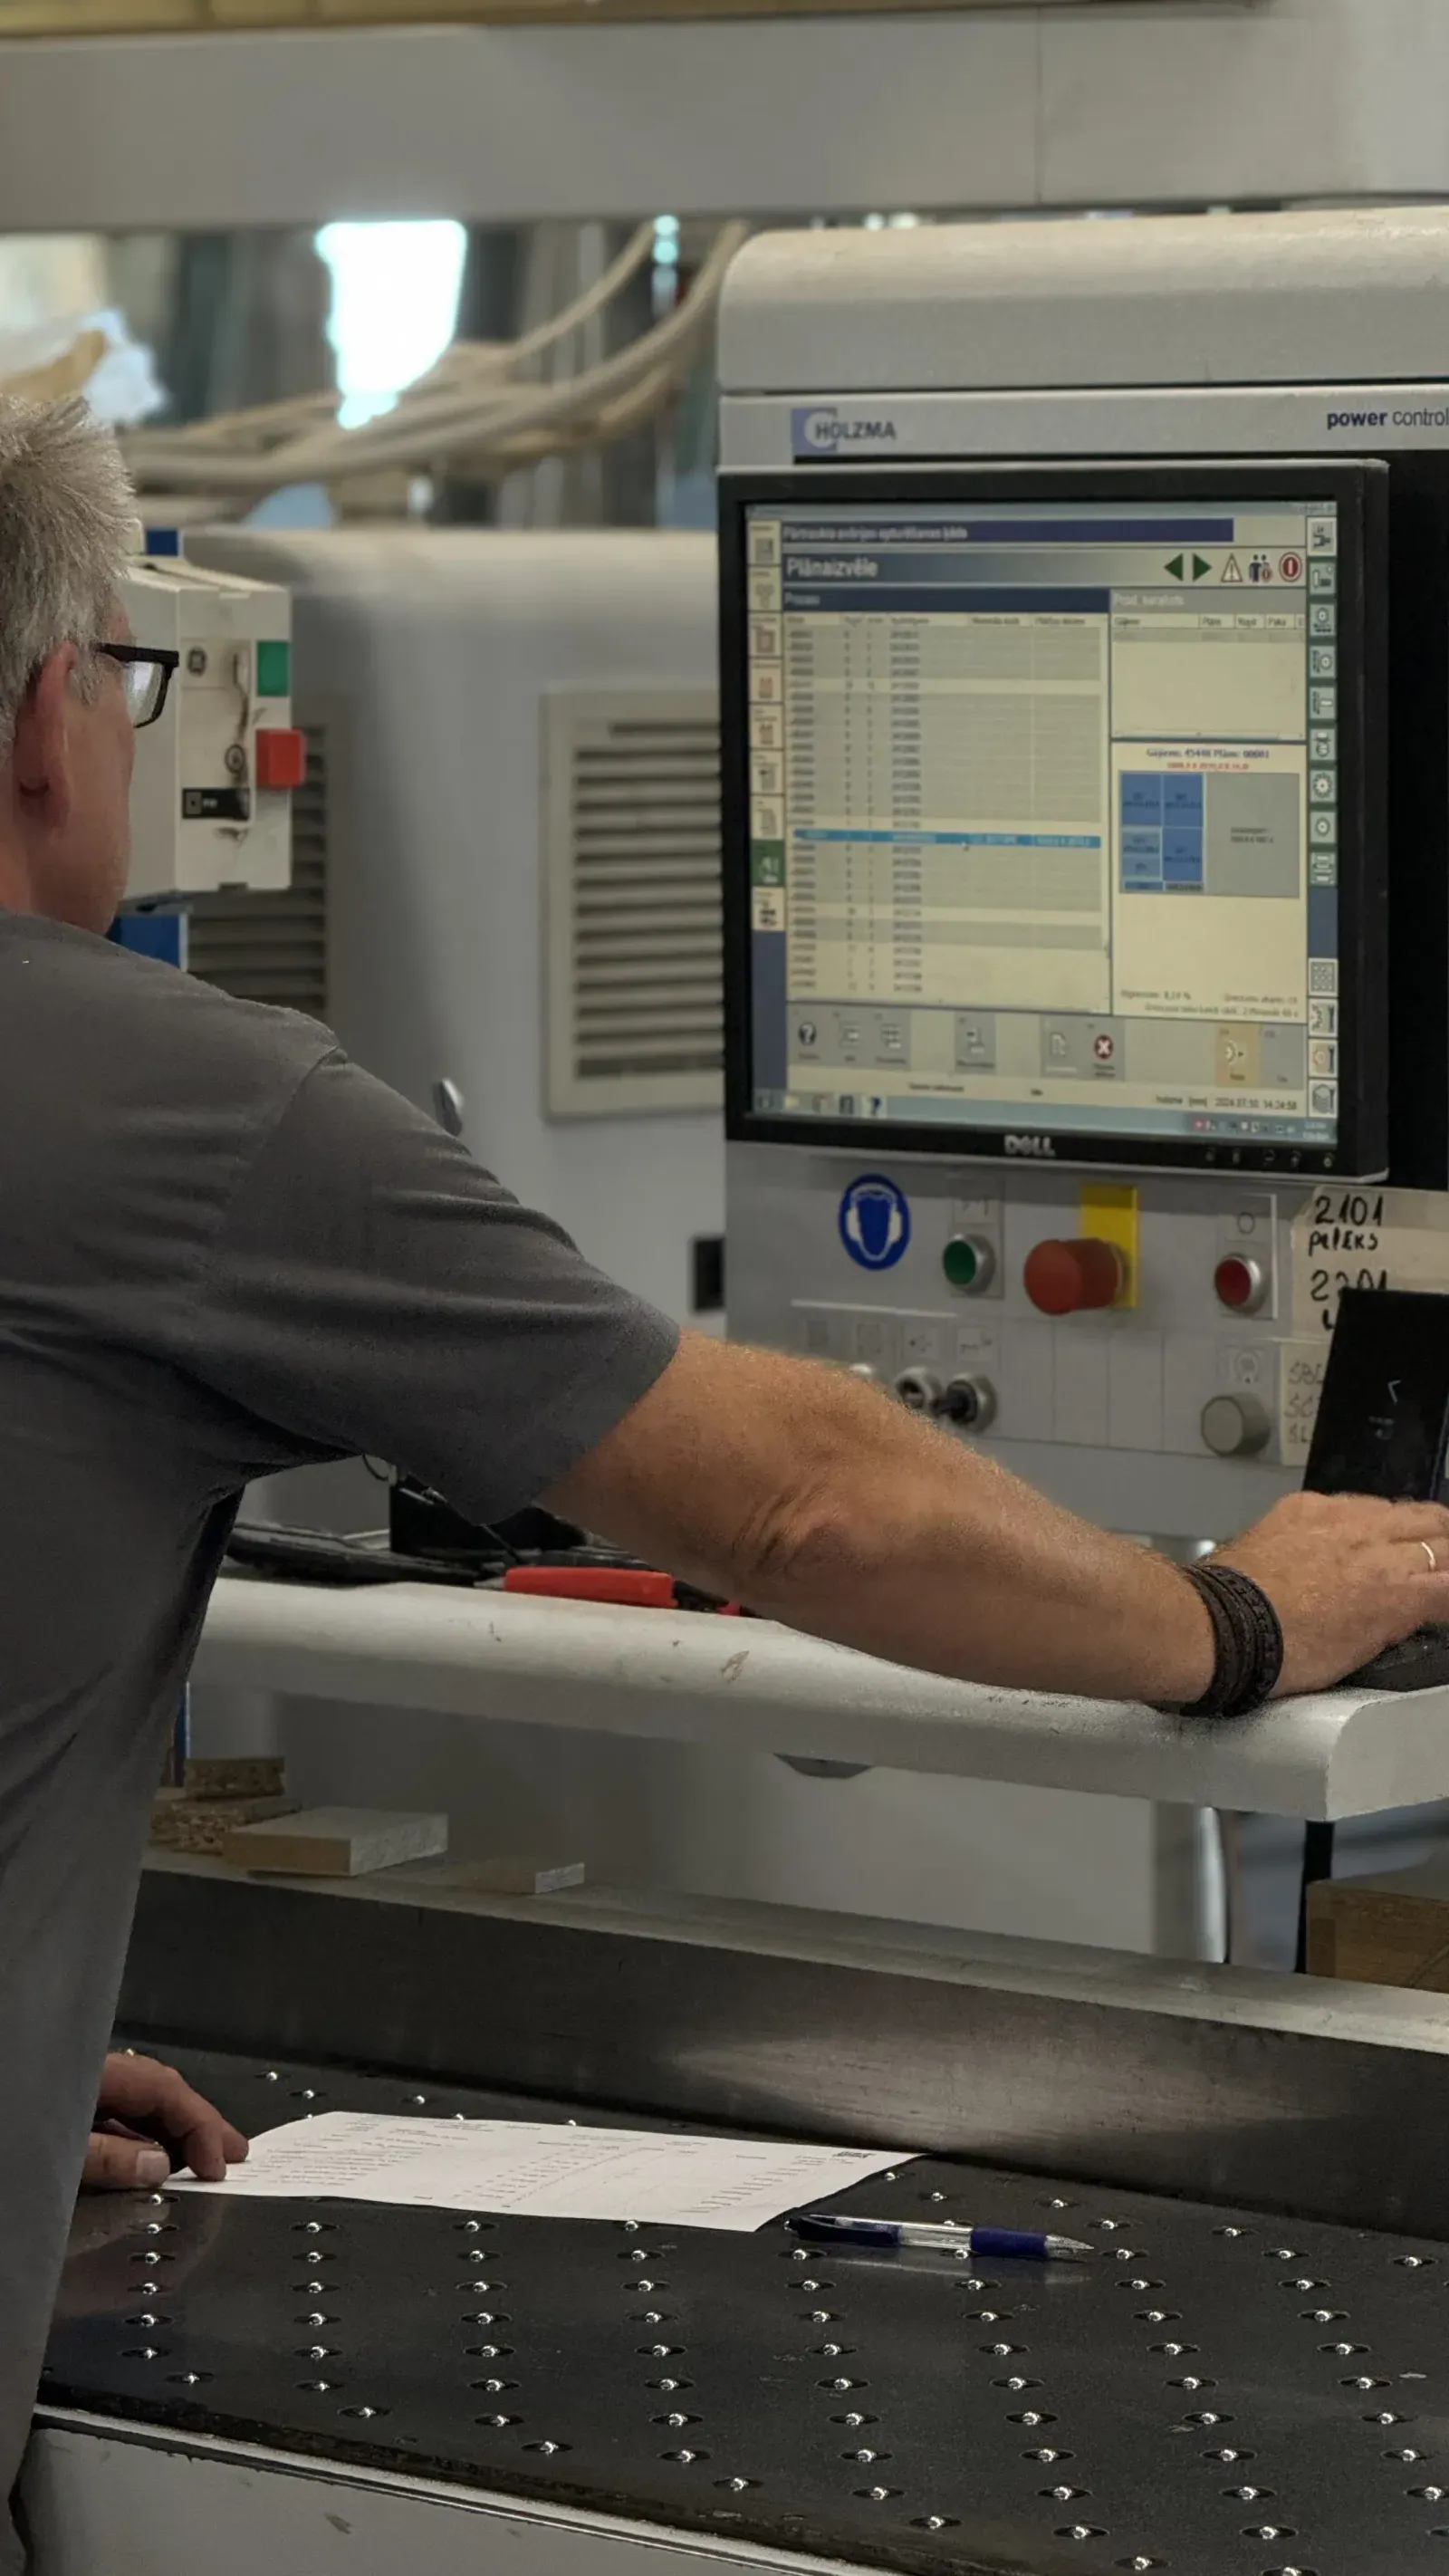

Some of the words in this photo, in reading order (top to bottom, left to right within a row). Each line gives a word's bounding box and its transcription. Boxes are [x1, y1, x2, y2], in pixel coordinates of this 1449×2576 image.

[816, 420, 897, 440] HOLZMA
[1327, 411, 1388, 430] power
[1392, 407, 1449, 427] control
[1003, 1134, 1056, 1157] DELL
[1314, 1193, 1384, 1227] 2101
